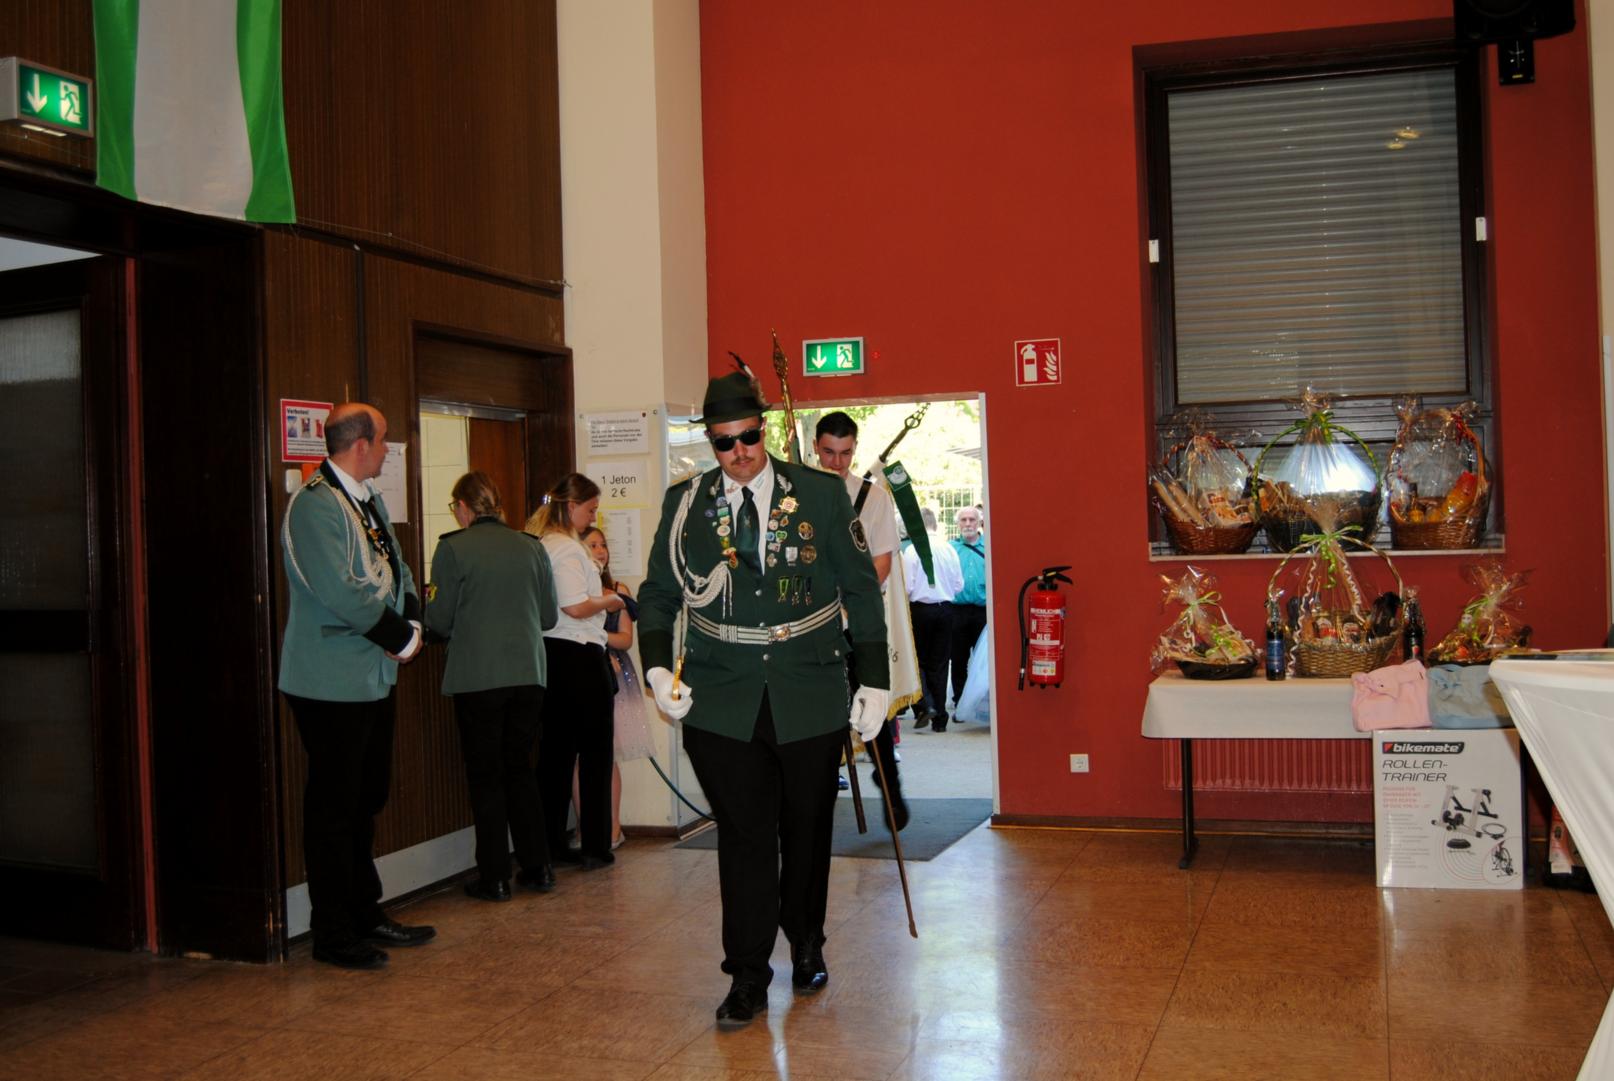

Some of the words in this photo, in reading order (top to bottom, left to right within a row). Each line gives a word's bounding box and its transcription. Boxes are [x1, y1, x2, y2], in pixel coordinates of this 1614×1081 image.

[602, 476, 606, 485] 1
[610, 475, 636, 485] Jeton
[611, 488, 618, 498] 2
[620, 487, 627, 498] €
[1393, 743, 1460, 753] bikemate
[1382, 759, 1448, 769] ROLLEN-
[1382, 772, 1447, 782] TRAINER
